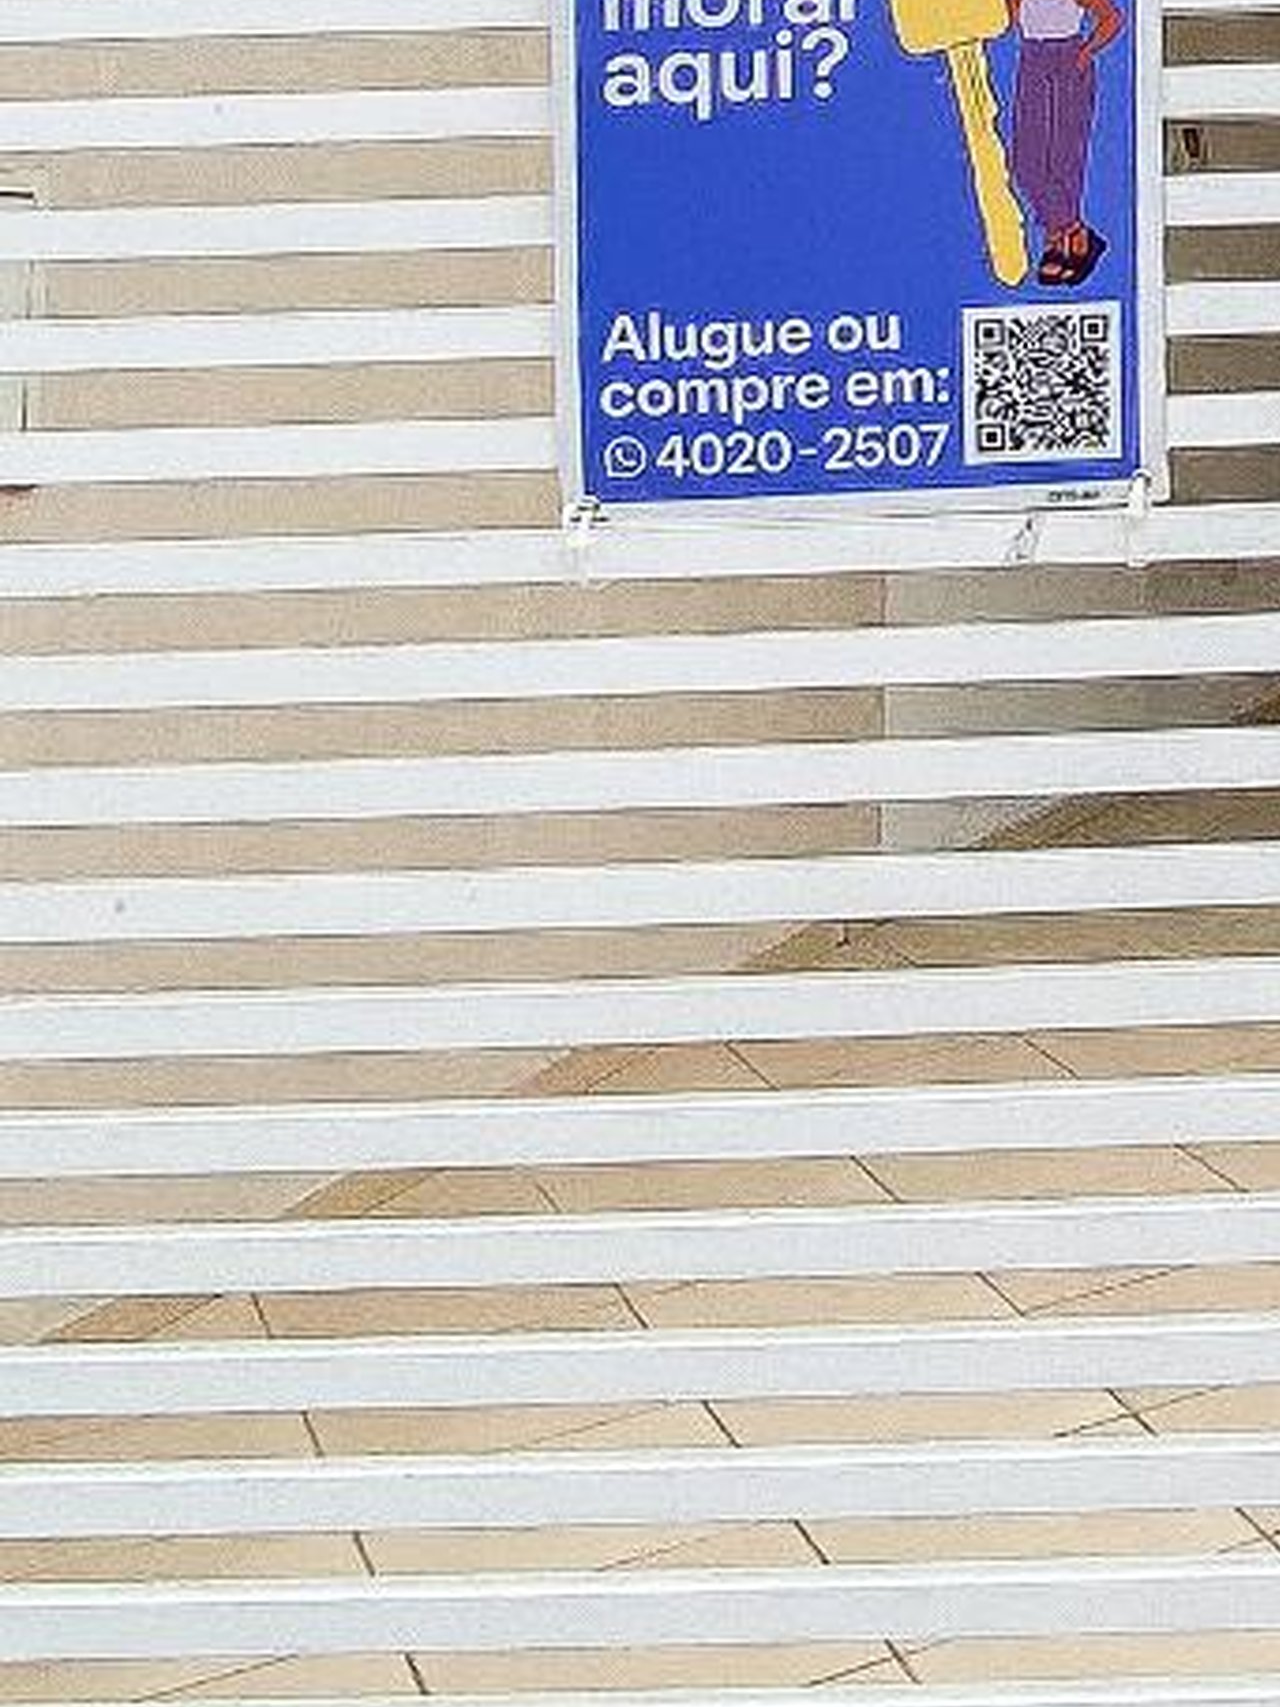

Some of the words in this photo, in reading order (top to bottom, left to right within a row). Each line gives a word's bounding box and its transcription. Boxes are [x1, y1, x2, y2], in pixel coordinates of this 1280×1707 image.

[603, 28, 850, 118] aqui?
[602, 311, 812, 369] Alugue
[829, 314, 901, 351] ou
[601, 372, 830, 424] compre
[846, 367, 951, 410] em:
[656, 425, 951, 478] 4020-2507
